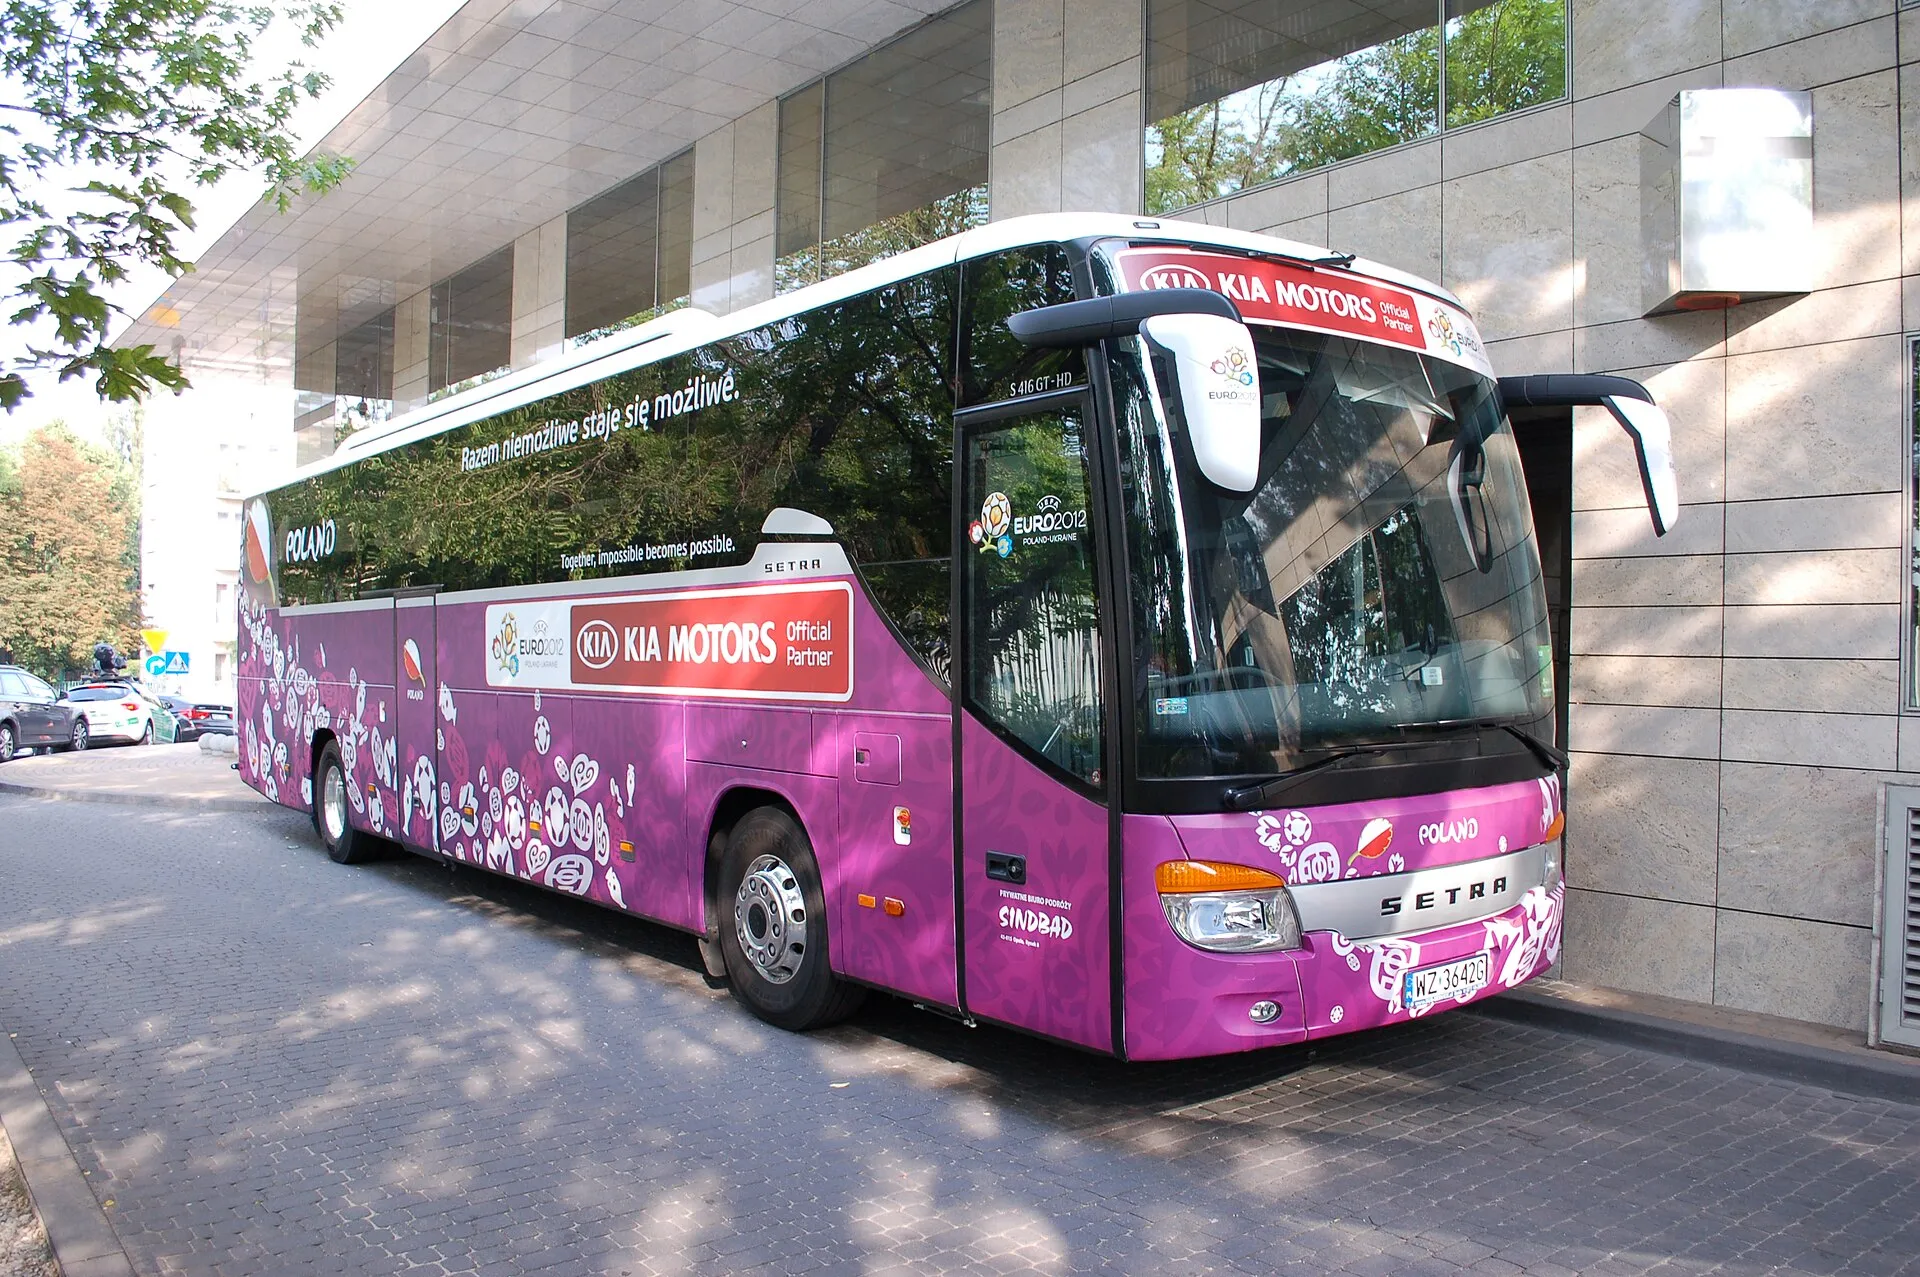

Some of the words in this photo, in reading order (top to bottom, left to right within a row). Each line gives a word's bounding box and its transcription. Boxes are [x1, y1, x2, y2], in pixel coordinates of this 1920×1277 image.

[1217, 272, 1271, 304] KIA
[1274, 279, 1377, 323] MOTORS
[1379, 301, 1411, 320] Official
[1382, 315, 1414, 334] Partner
[1009, 382, 1016, 397] S
[1017, 379, 1034, 396] 416
[461, 442, 500, 472] Razem
[502, 419, 579, 461] niemożliwe
[581, 403, 621, 442] staje
[624, 394, 650, 431] się
[653, 374, 740, 421] możliwe.
[1014, 509, 1088, 535] EURO2012
[285, 517, 336, 564] POLAND
[1022, 532, 1078, 546] POLAND-UKRAINE
[560, 553, 597, 572] Together,
[598, 544, 644, 568] impossible
[645, 541, 688, 560] becomes
[689, 533, 736, 560] possible.
[764, 558, 821, 573] SETRA
[624, 626, 662, 662] KIA
[667, 621, 777, 664] MOTORS
[786, 620, 831, 642] Official
[519, 638, 564, 656] EURO2012
[583, 631, 612, 658] KIA
[786, 646, 834, 667] Partner
[406, 688, 424, 701] POLAND
[1418, 816, 1479, 846] POLAND
[1380, 876, 1507, 916] SETRA
[998, 905, 1073, 940] SINDBAD
[1415, 970, 1438, 998] WZ
[1443, 959, 1484, 991] 3642G
